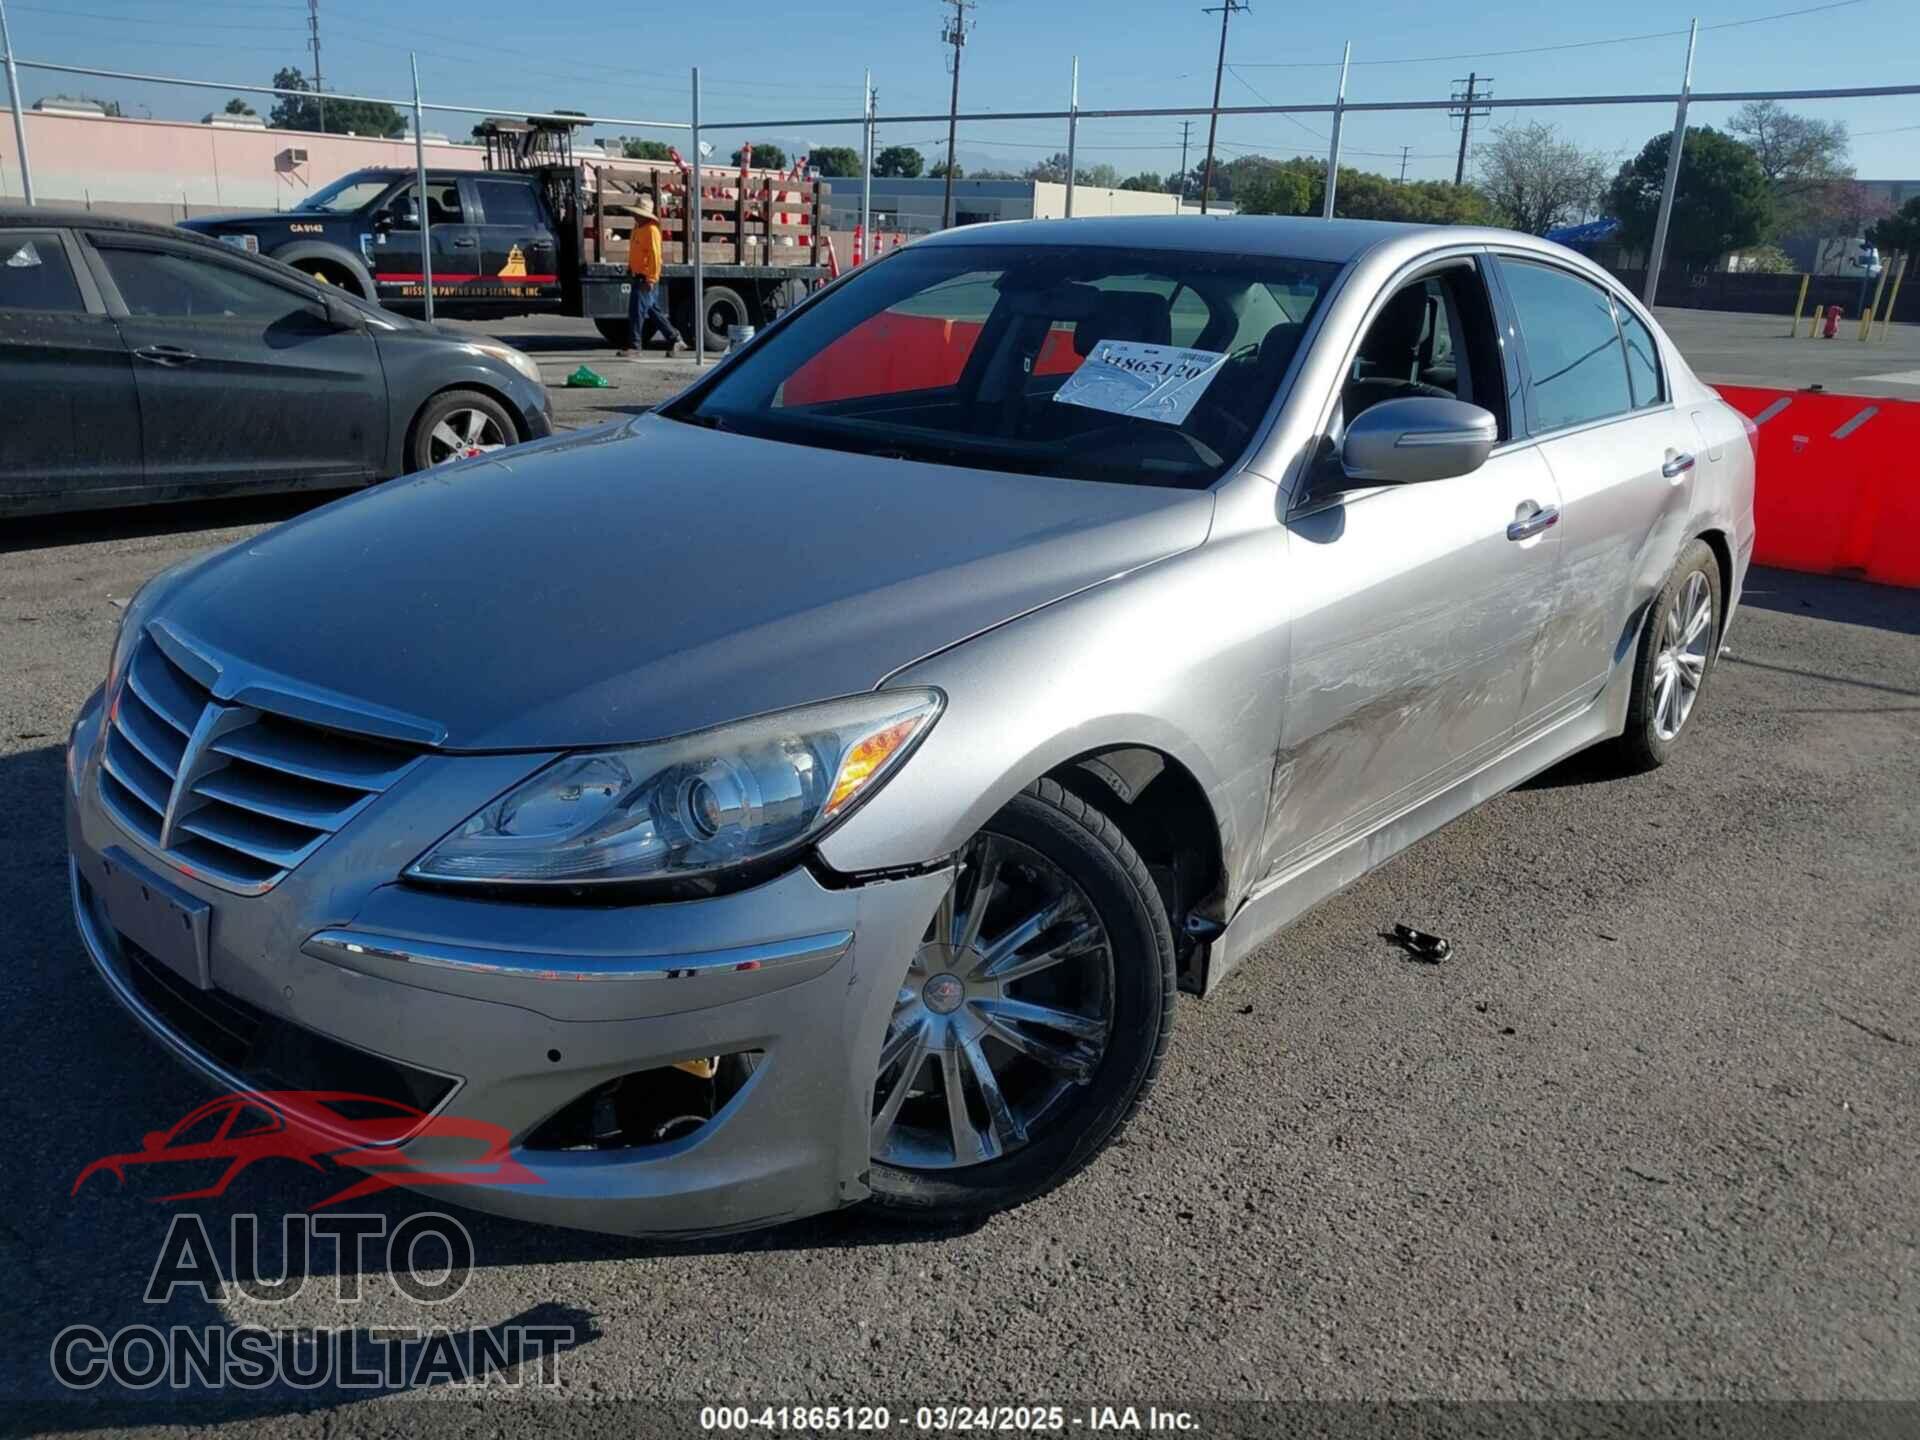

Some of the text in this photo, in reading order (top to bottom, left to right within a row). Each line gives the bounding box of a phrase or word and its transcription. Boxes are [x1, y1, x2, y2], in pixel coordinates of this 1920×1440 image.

[289, 223, 304, 233] CA
[402, 286, 438, 297] MISSIN
[439, 286, 470, 297] PAVING
[471, 286, 488, 297] AND
[525, 286, 542, 297] INC.
